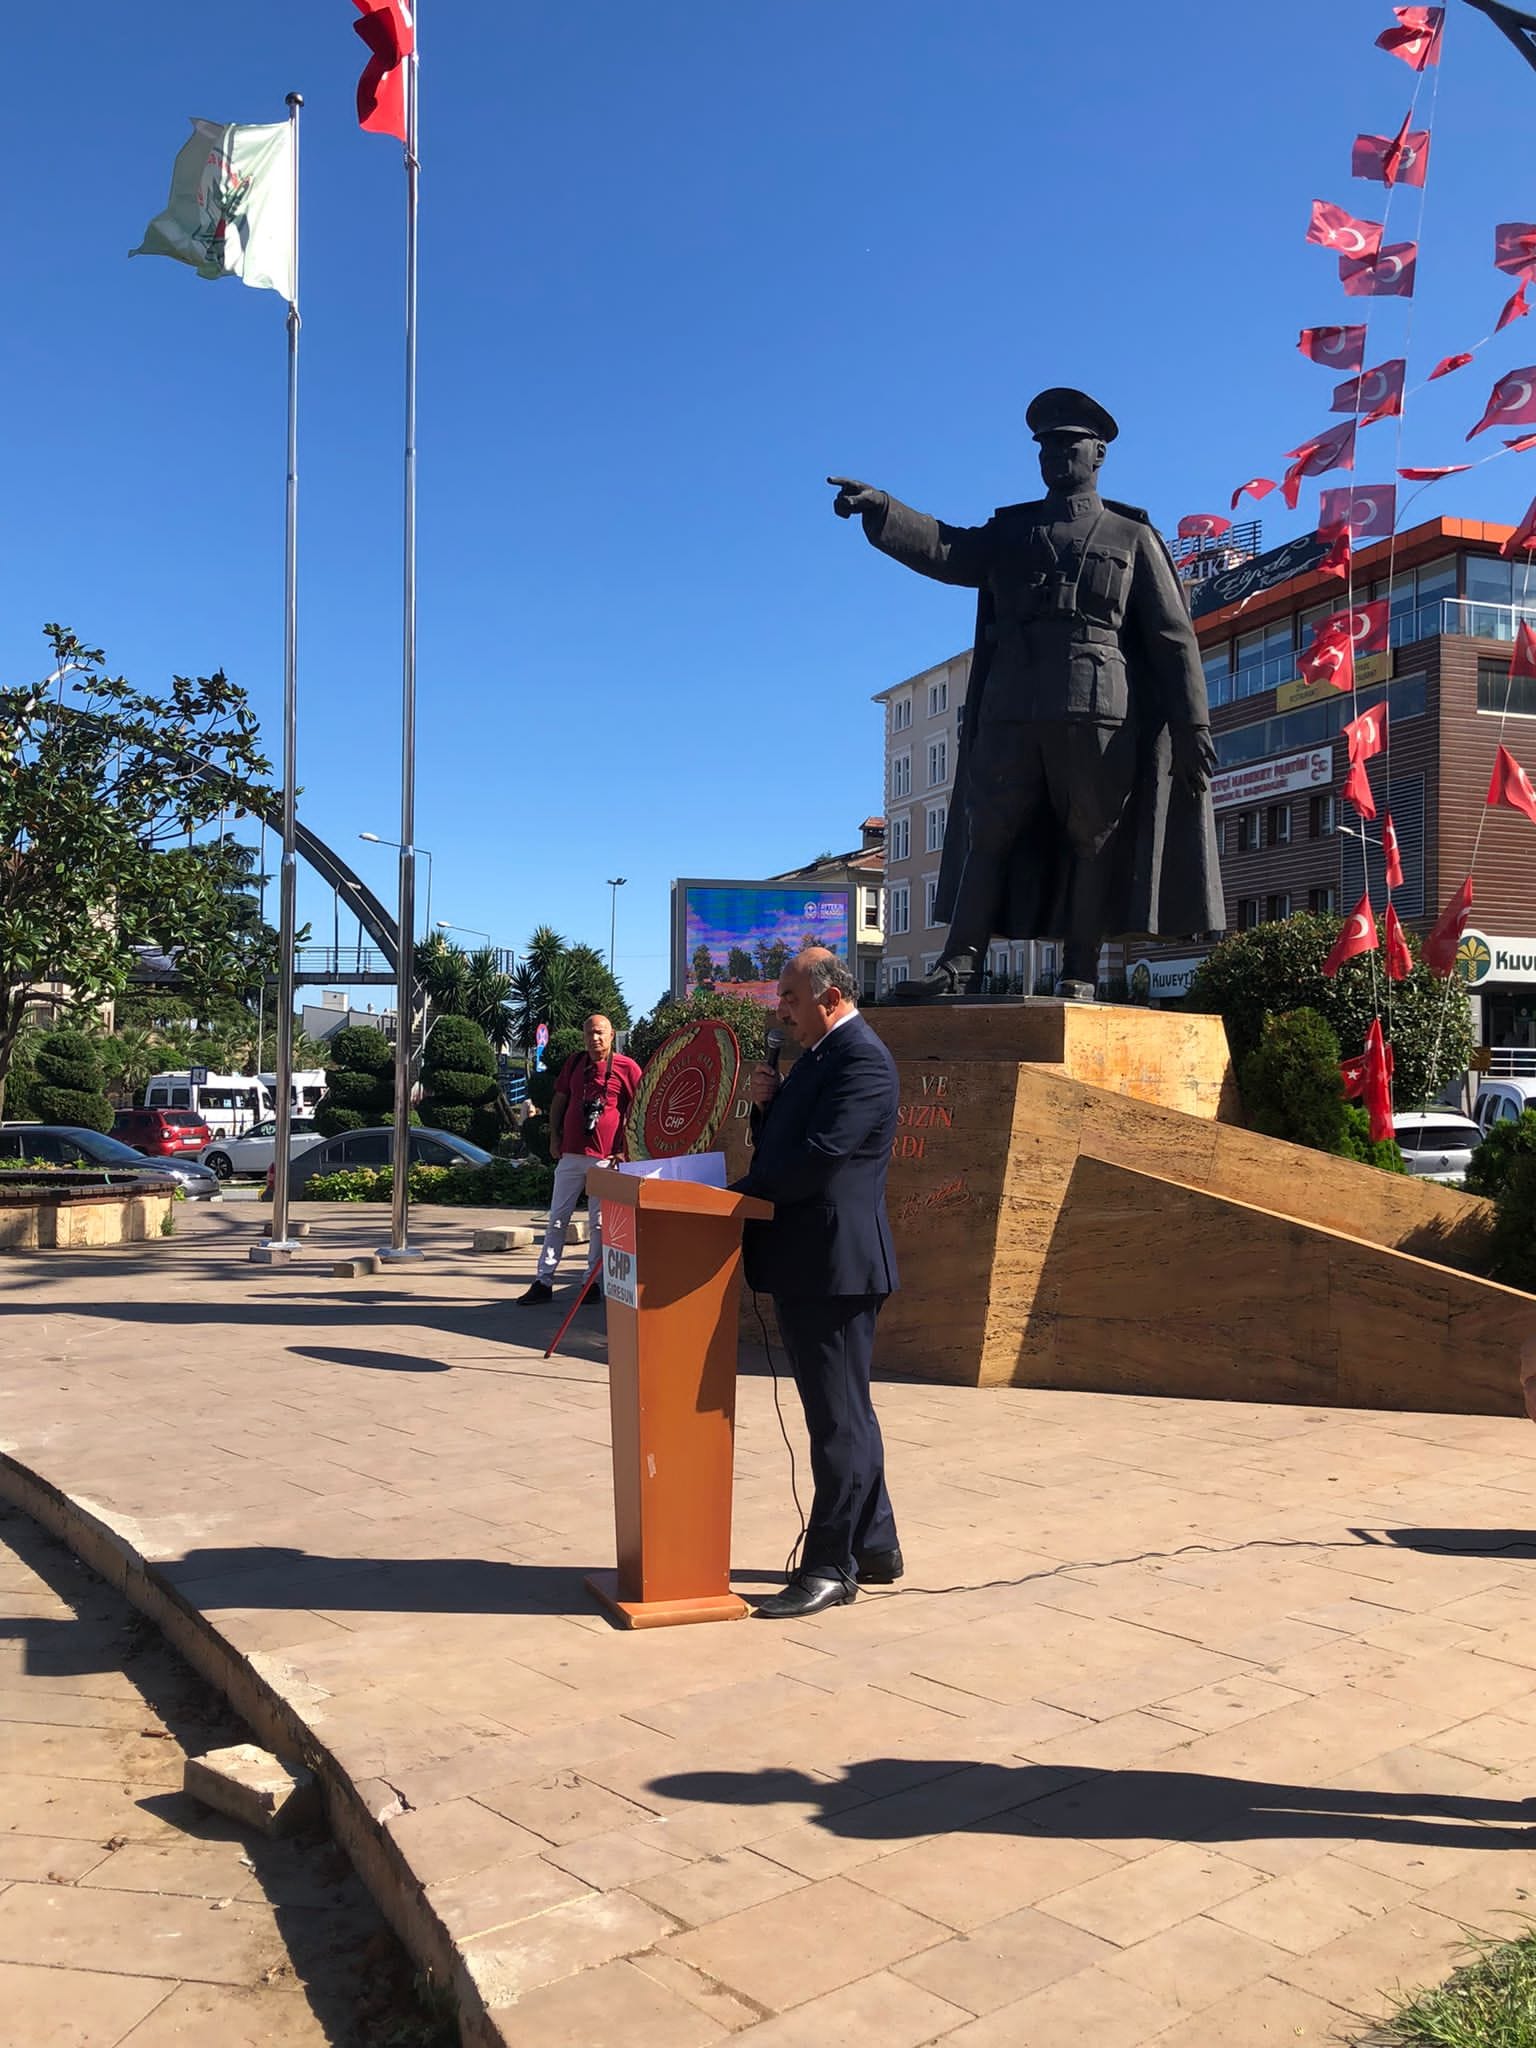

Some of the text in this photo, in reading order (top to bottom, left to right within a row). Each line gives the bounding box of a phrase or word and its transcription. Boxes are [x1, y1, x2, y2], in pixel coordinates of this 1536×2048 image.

[921, 1075, 948, 1096] VE
[664, 1116, 685, 1130] CHP
[607, 1247, 631, 1281] CHP
